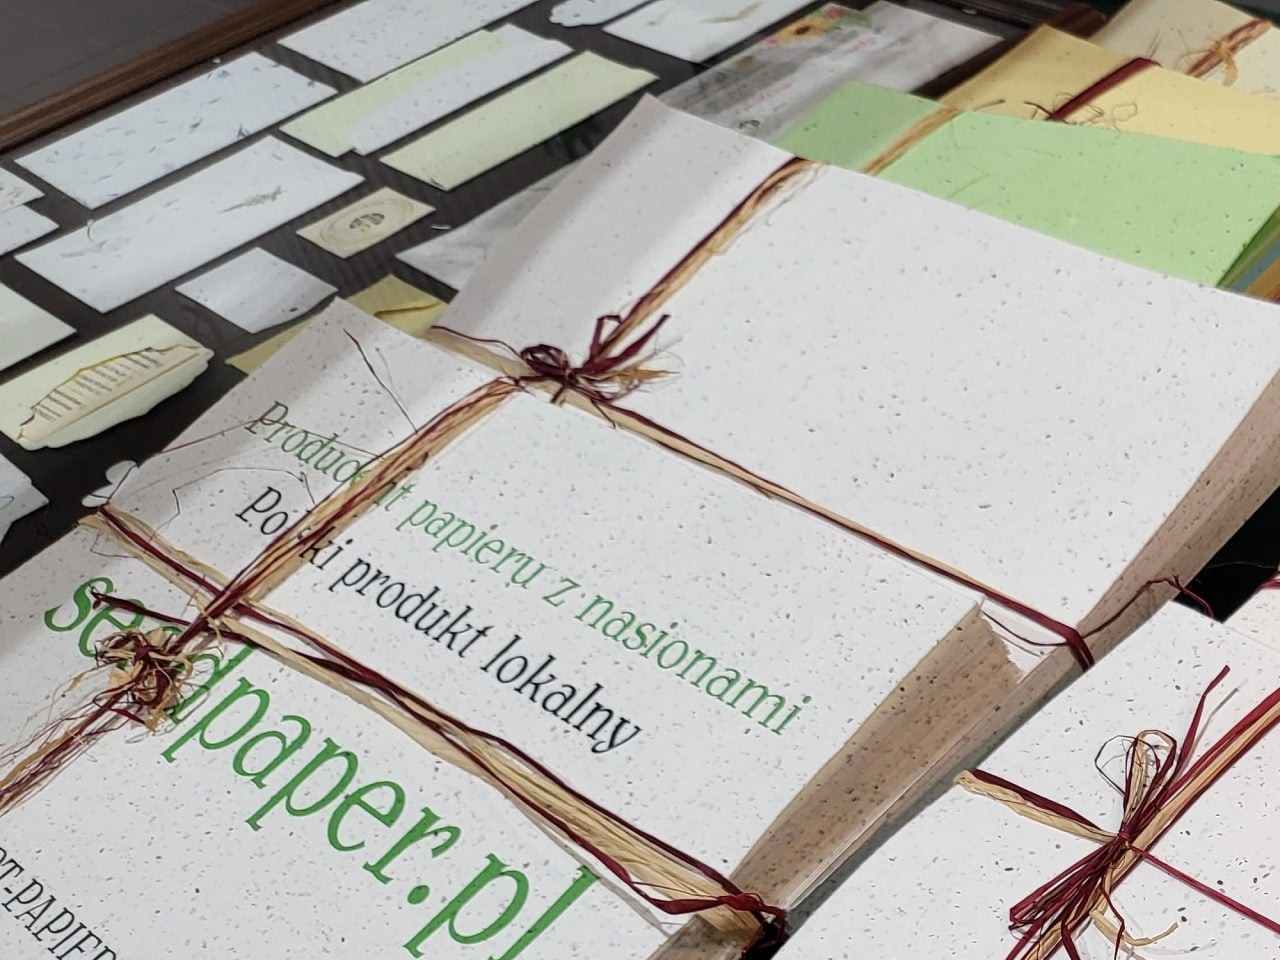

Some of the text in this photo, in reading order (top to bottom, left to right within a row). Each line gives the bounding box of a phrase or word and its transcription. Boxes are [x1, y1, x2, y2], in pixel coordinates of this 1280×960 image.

[235, 486, 642, 754] Poki produkt lokalny
[395, 500, 548, 589] papieru
[542, 576, 580, 607] z
[574, 595, 812, 735] nasionami
